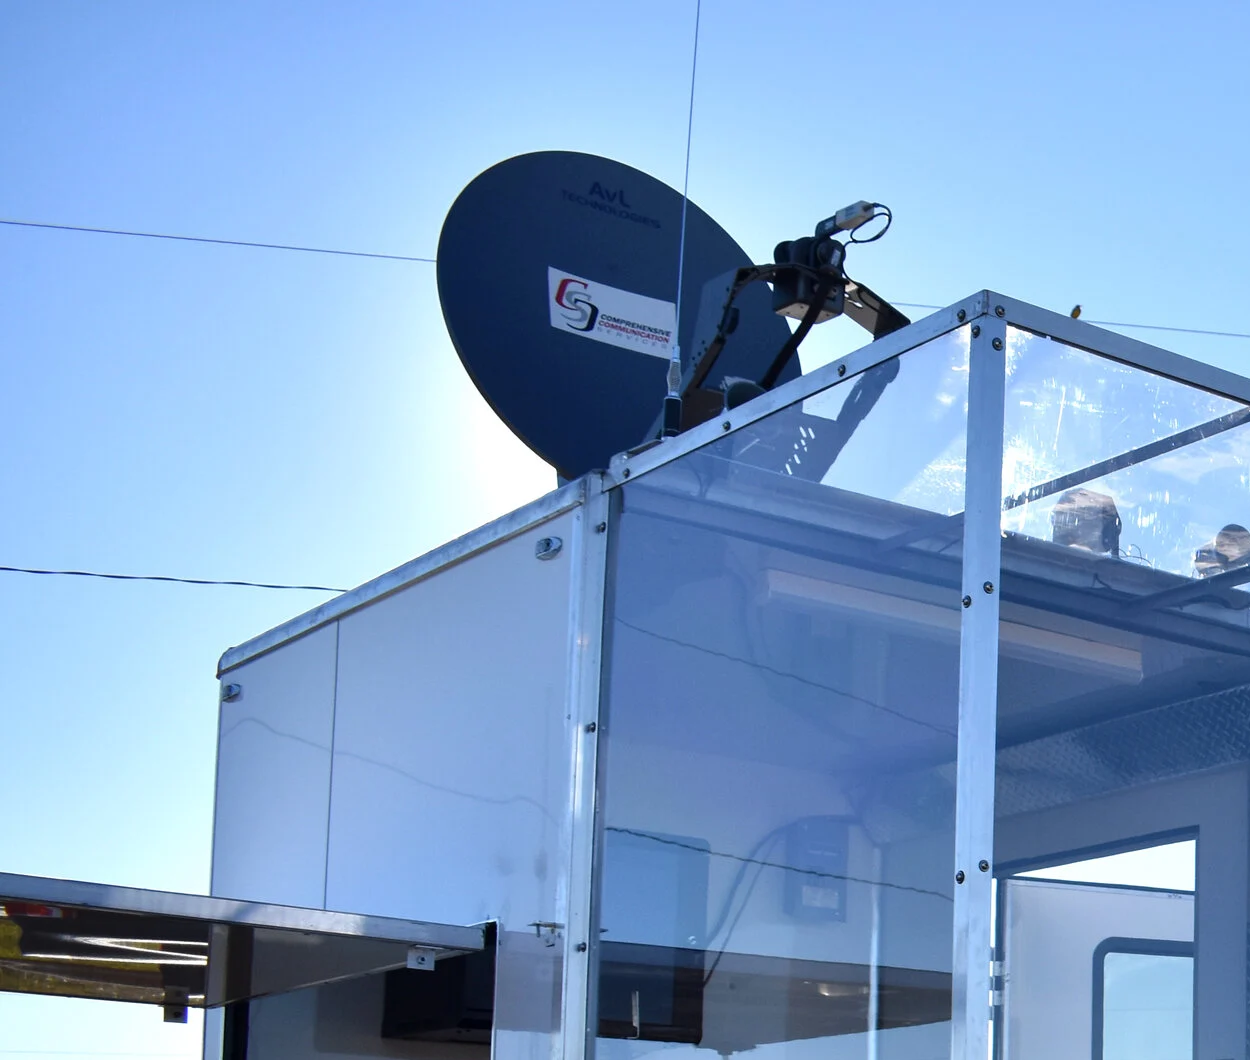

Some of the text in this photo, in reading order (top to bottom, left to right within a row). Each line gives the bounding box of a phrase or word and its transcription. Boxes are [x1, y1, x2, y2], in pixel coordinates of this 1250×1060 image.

[589, 181, 631, 209] AvL
[561, 188, 662, 230] TECHNOLOGIES
[598, 320, 671, 344] COMMUNICATION
[600, 313, 672, 338] COMPREHENSIVE
